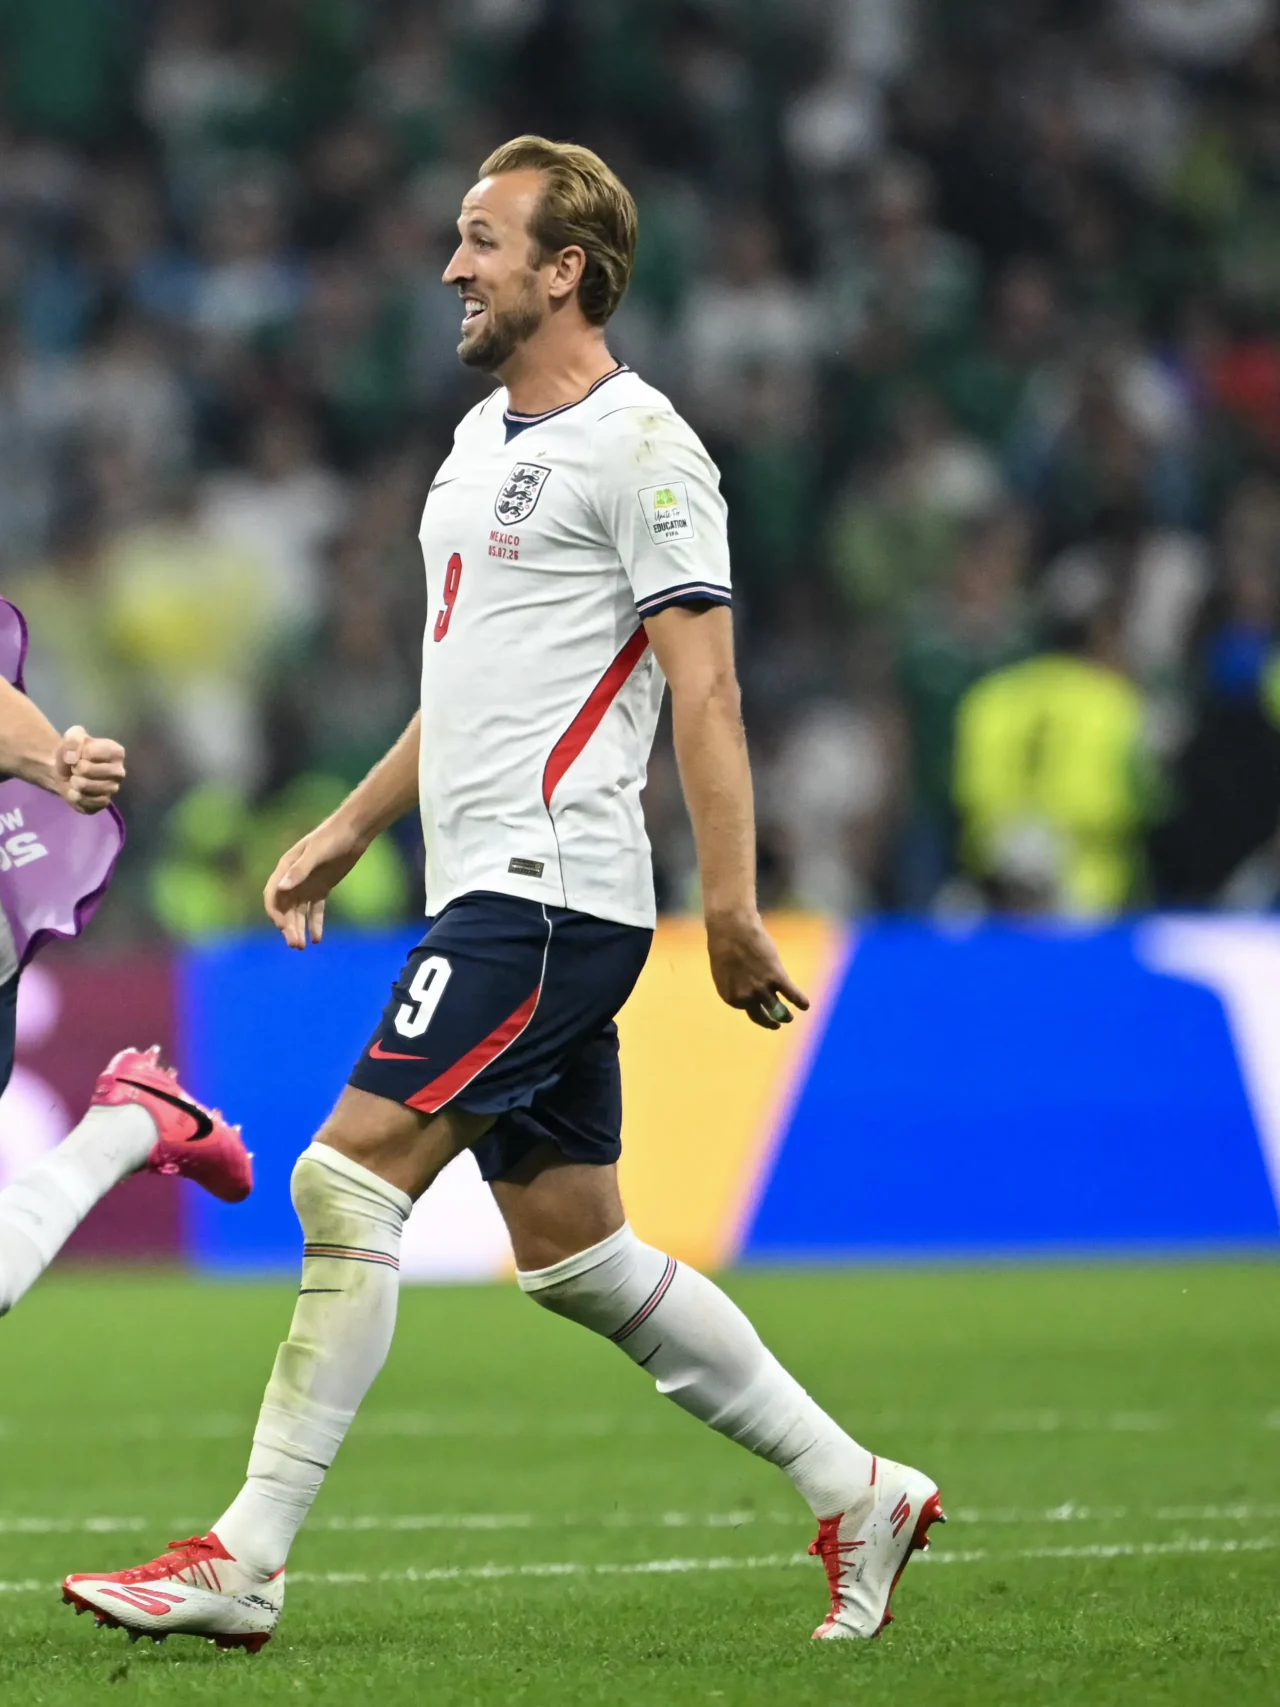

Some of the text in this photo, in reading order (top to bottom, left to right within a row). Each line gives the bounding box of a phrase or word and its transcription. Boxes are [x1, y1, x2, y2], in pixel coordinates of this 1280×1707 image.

[653, 519, 688, 534] EDUCATION
[489, 530, 520, 546] MEXICO
[488, 545, 519, 560] 05.07.26
[433, 552, 463, 643] 9
[393, 956, 453, 1039] 9
